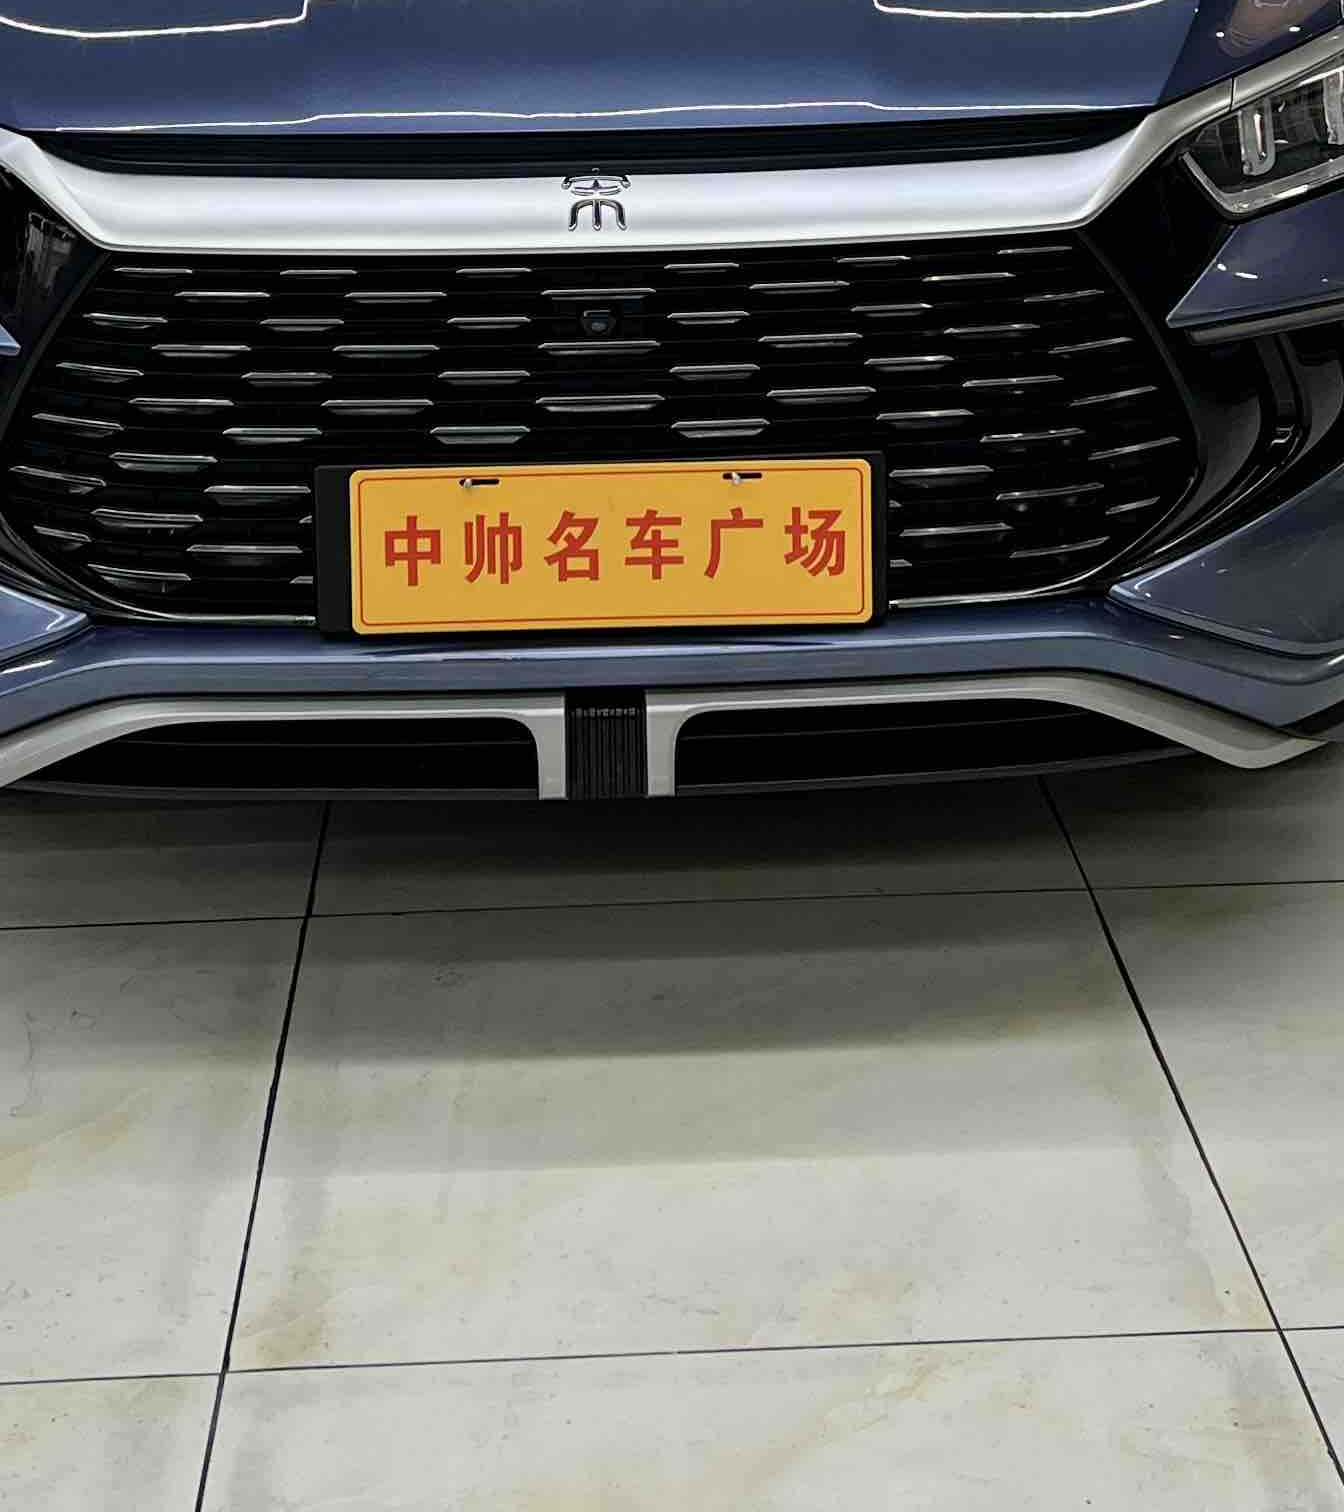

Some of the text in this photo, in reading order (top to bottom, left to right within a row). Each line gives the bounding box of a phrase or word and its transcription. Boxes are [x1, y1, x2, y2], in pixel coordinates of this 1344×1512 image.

[383, 506, 847, 587] 中帅名车广场
